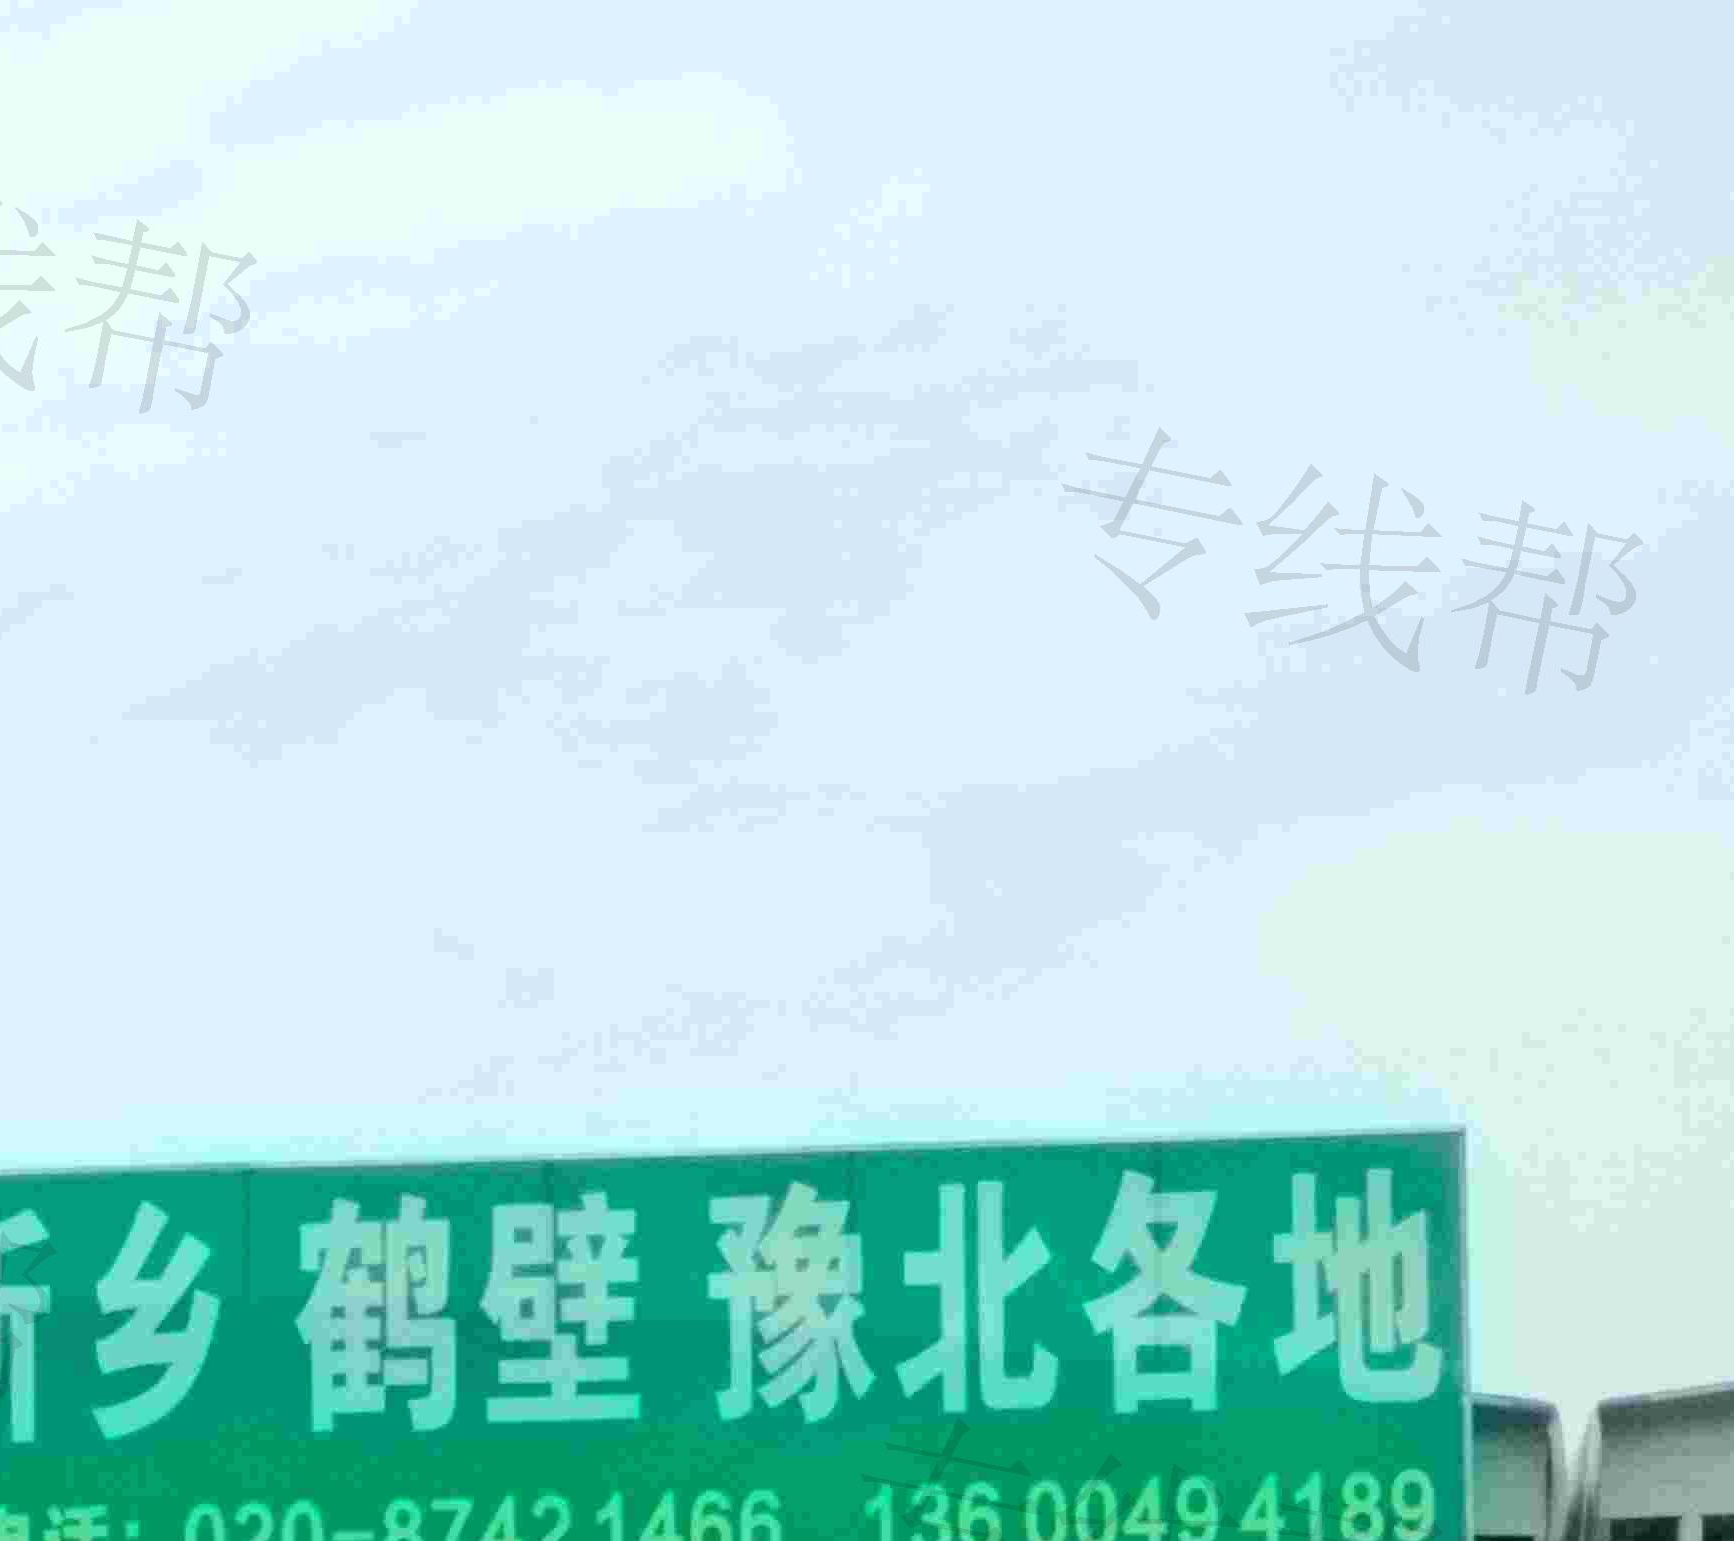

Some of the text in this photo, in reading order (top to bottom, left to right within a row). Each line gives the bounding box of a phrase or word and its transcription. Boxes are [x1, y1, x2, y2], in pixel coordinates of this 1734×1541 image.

[294, 1191, 641, 1432] 鹤壁
[707, 1168, 1444, 1424] 豫北各地
